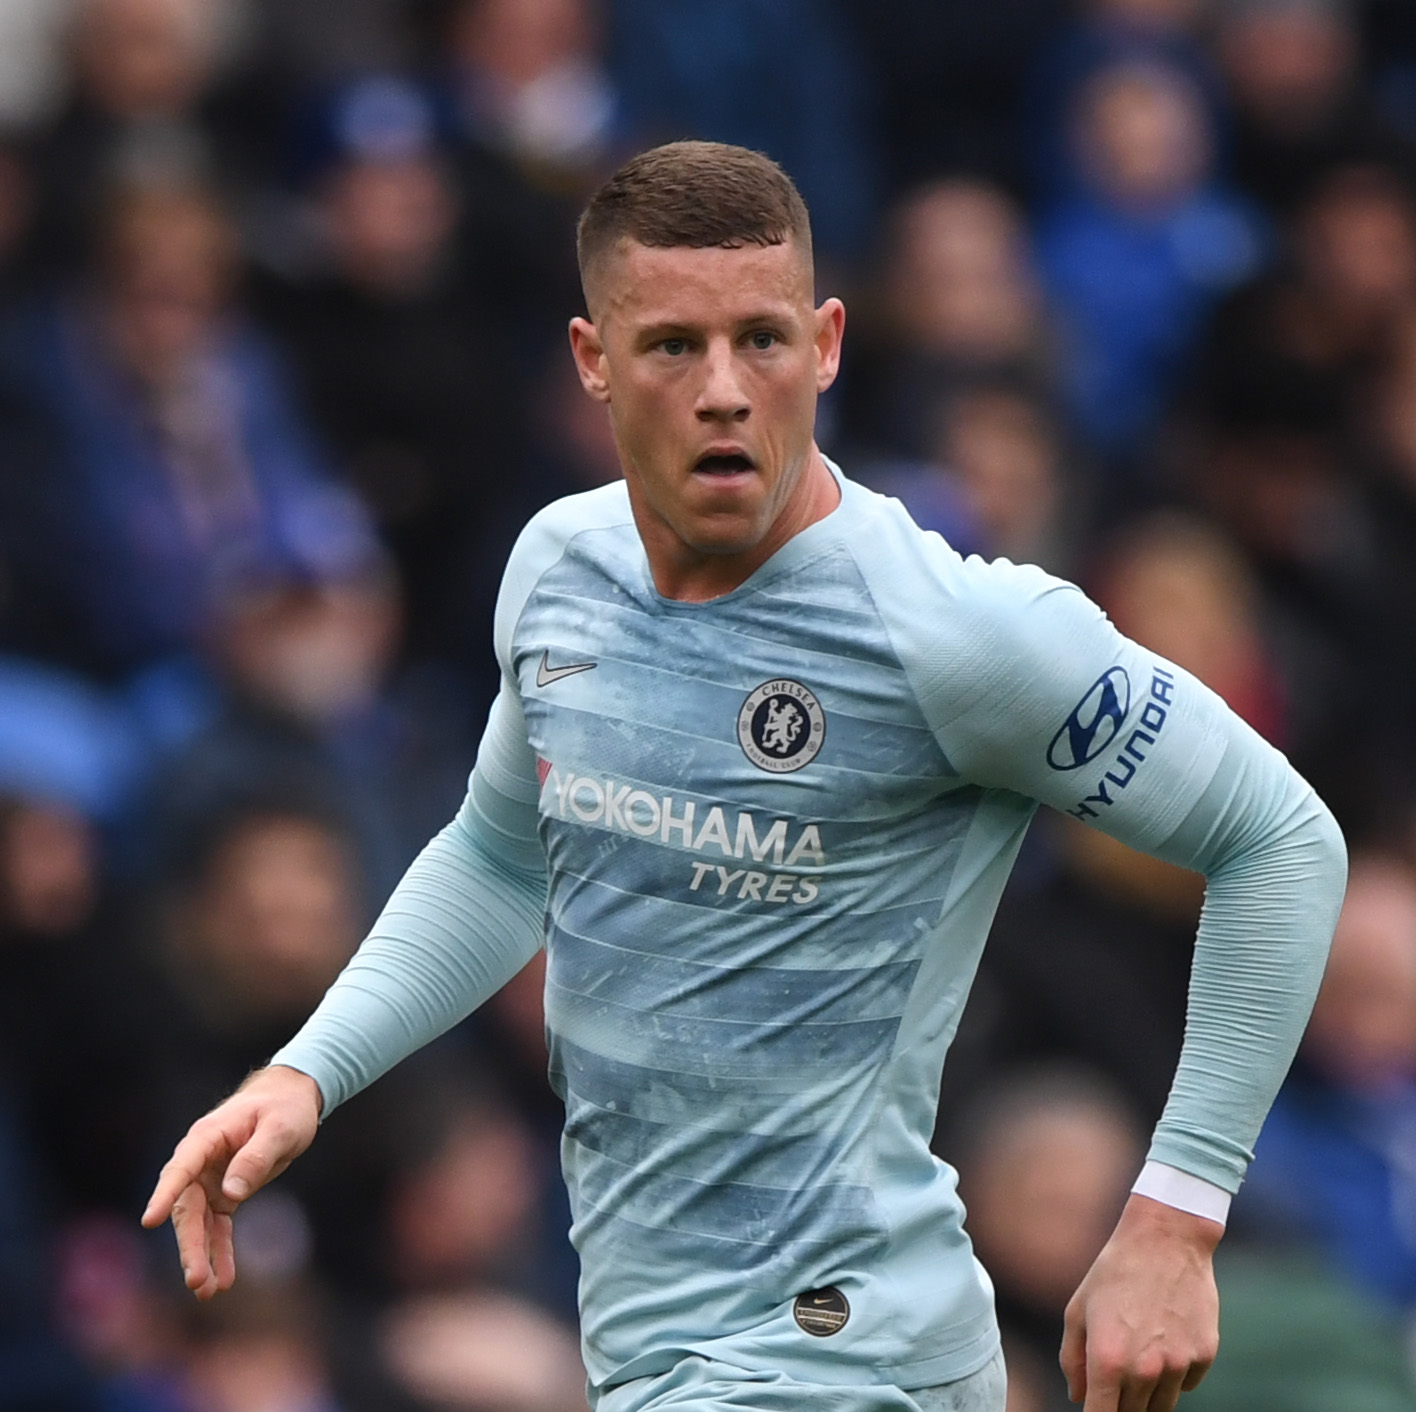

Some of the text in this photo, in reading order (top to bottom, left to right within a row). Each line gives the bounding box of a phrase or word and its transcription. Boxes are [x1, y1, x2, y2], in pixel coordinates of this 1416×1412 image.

[762, 683, 816, 710] CHELSEA
[1066, 666, 1174, 821] HYUNDAI
[550, 769, 826, 866] YOKOHAMA
[689, 861, 823, 904] TYRES
